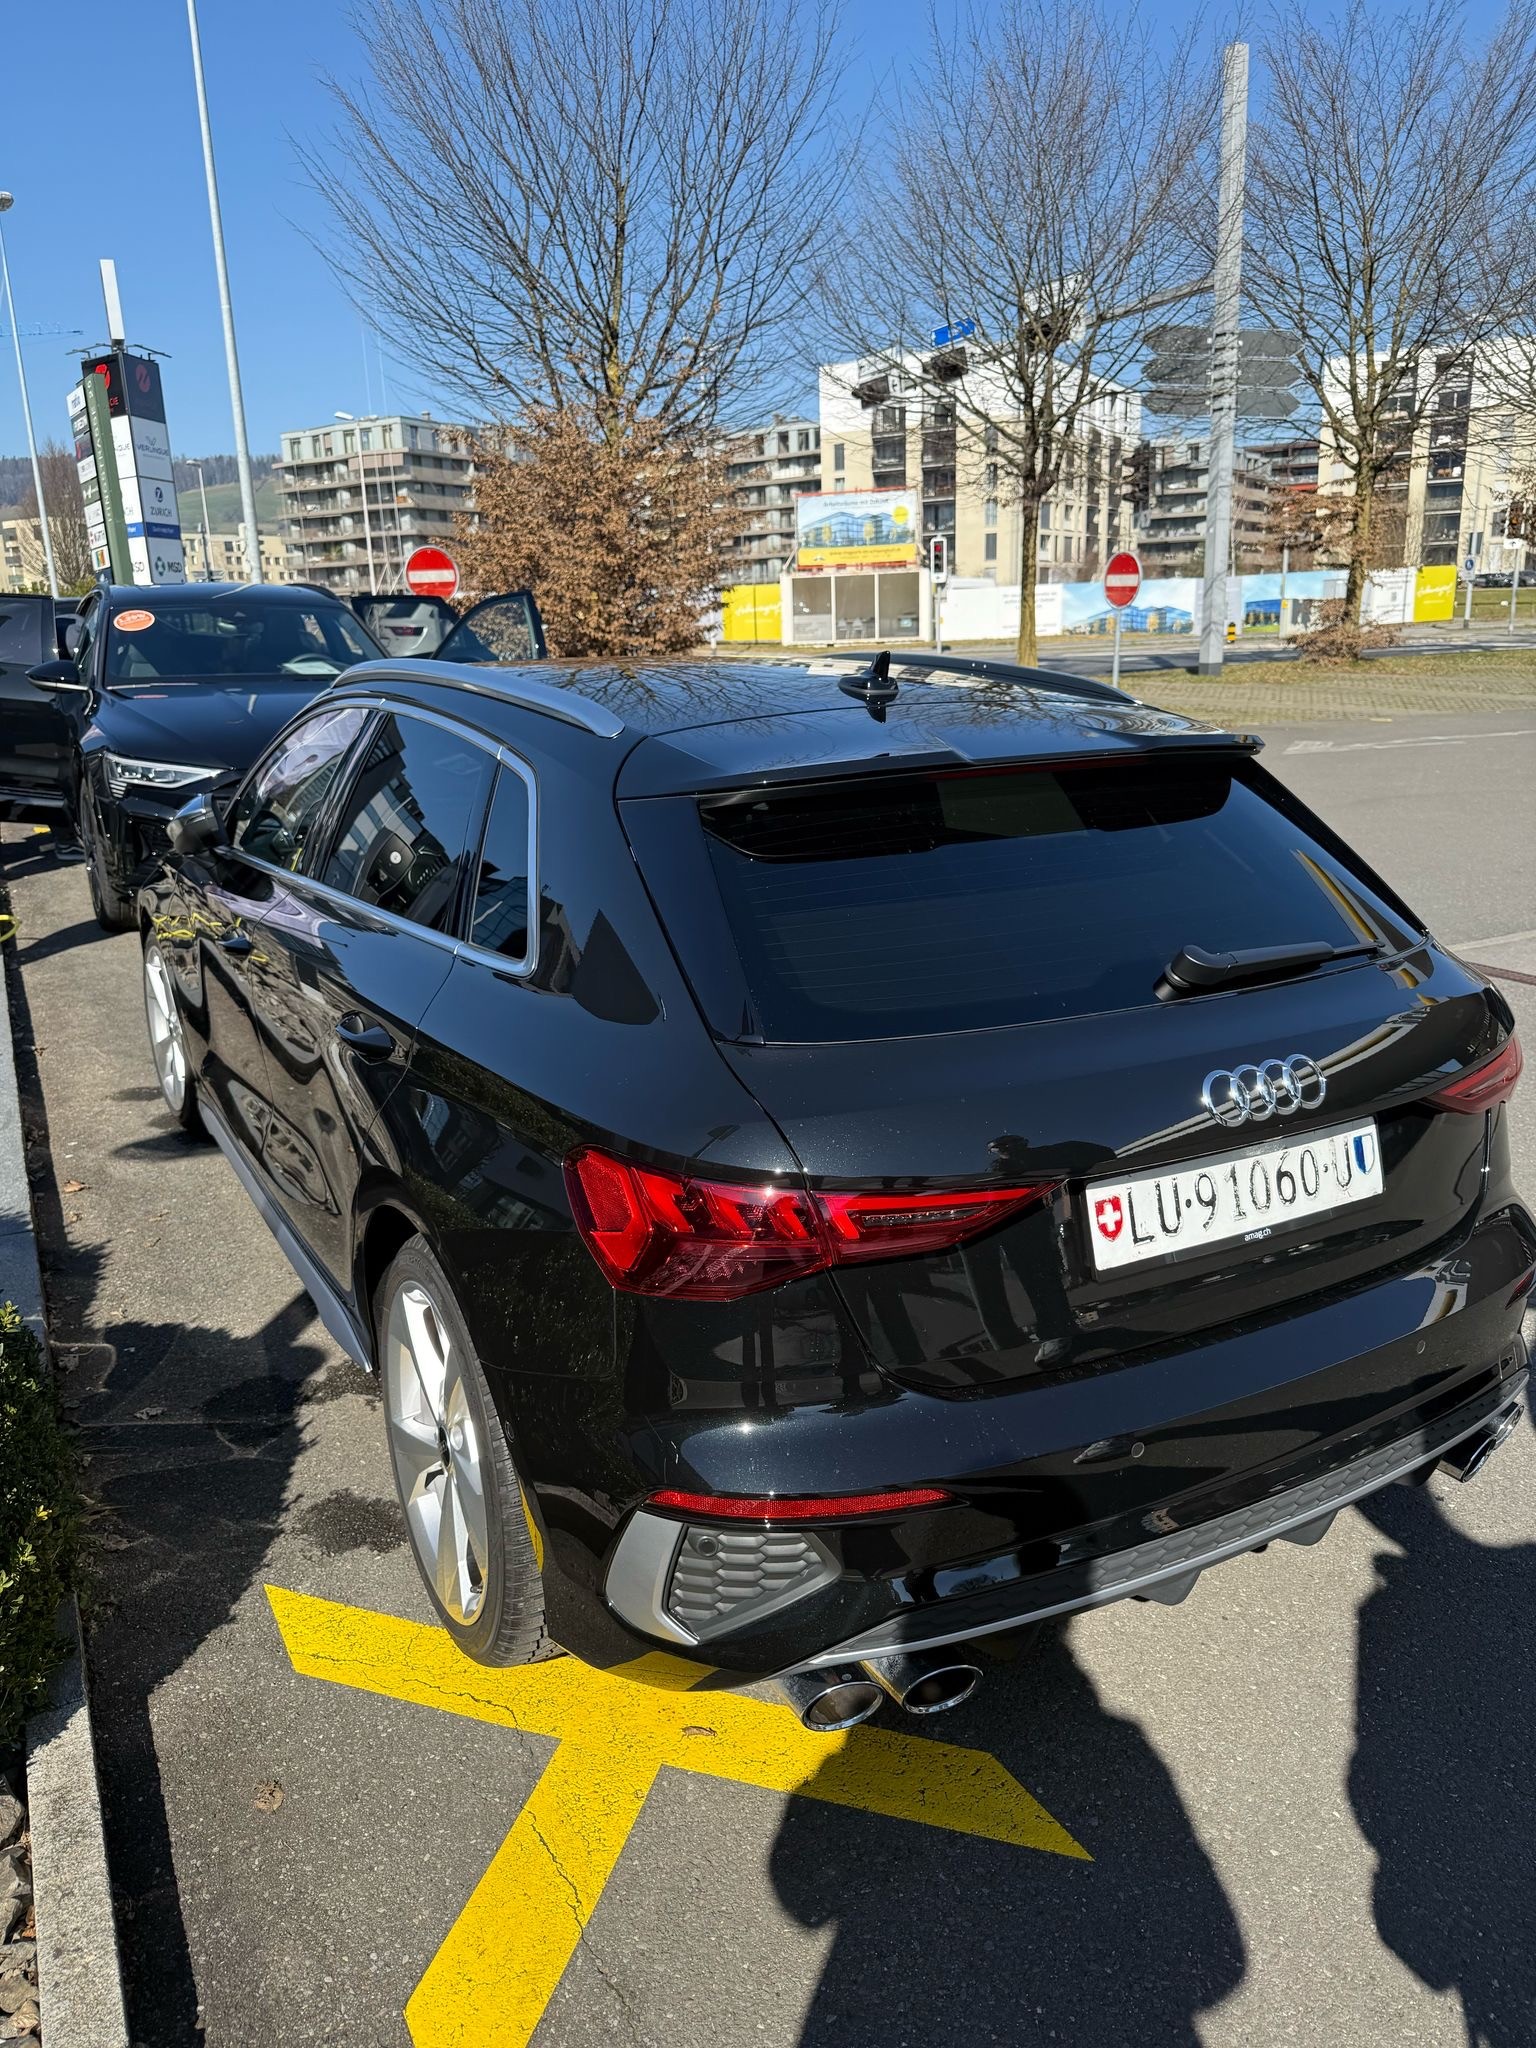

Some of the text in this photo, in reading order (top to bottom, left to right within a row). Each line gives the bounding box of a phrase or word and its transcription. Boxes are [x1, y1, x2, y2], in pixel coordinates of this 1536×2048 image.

[150, 506, 172, 518] ZURICH
[167, 561, 183, 573] MSD
[1244, 1227, 1272, 1242] amag.ch
